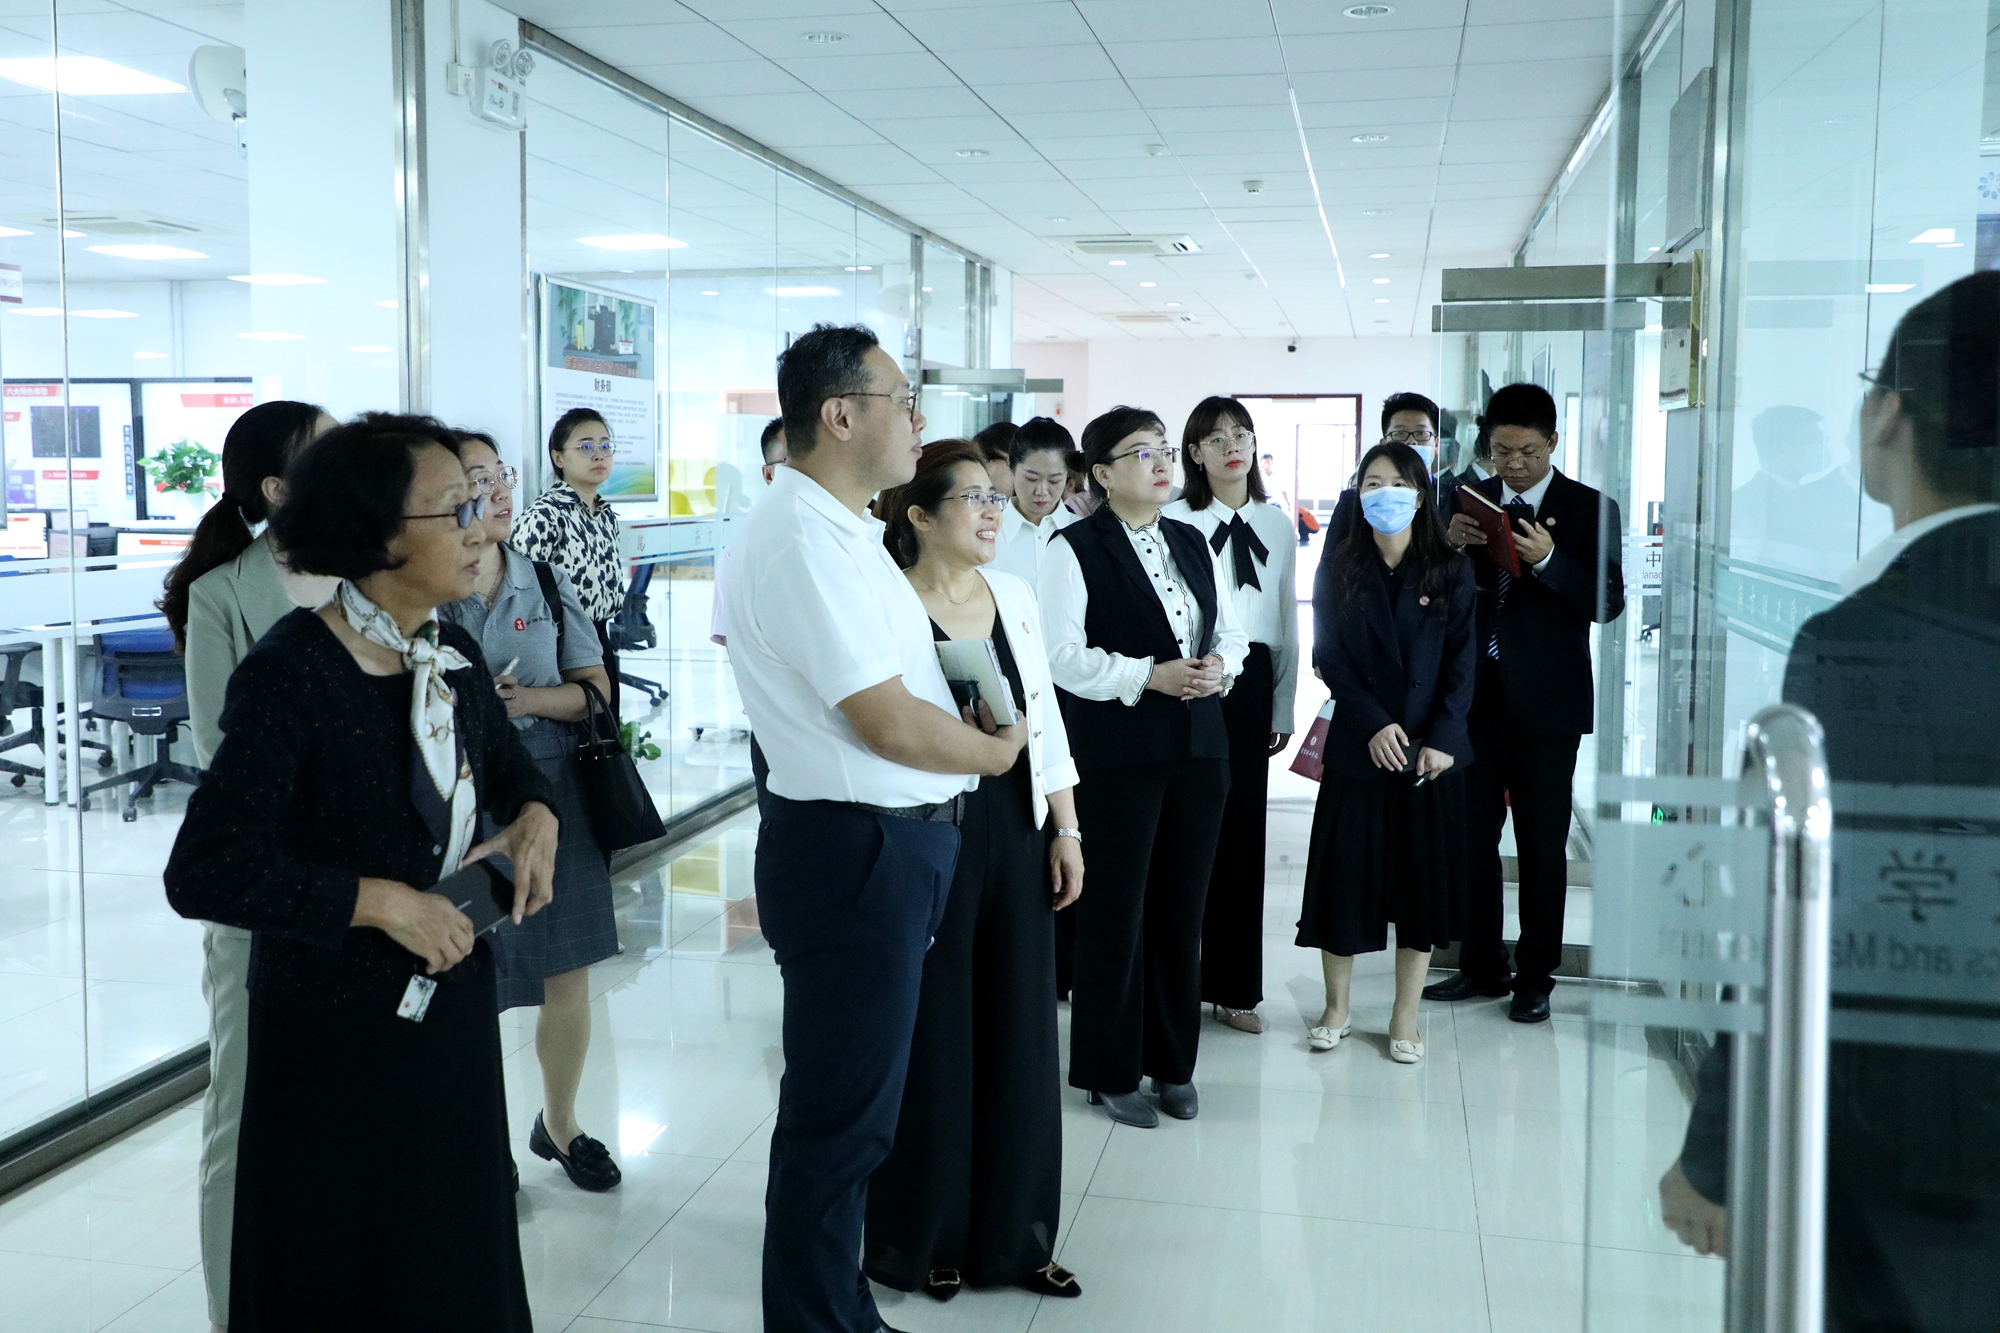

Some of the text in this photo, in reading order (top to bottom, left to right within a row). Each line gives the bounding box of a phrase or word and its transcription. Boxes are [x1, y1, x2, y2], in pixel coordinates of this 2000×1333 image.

[594, 378, 612, 393] 财务部
[1645, 550, 1661, 567] 中
